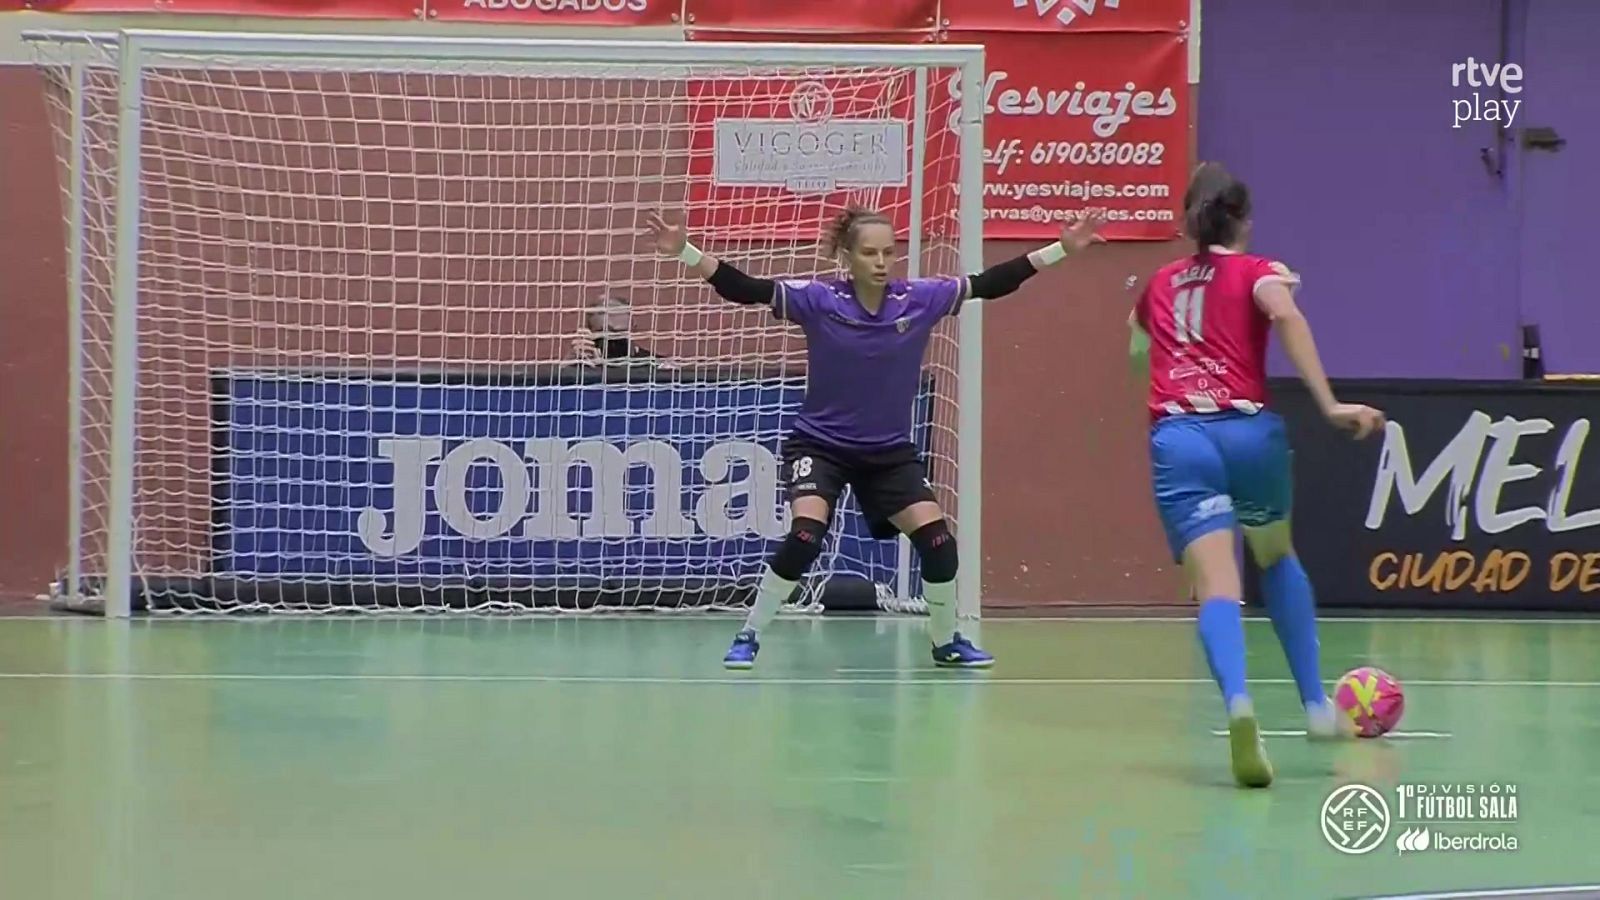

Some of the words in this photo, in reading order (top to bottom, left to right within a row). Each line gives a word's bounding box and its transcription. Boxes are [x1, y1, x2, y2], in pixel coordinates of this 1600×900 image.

[982, 139, 1024, 176] elf:
[1030, 142, 1165, 166] 619038082
[951, 180, 1170, 200] ww.yesviajes.com
[1173, 286, 1205, 344] 11
[357, 436, 793, 557] Joma
[1364, 410, 1600, 541] MEL
[1369, 549, 1531, 593] CIUDAD
[1549, 552, 1600, 592] DE
